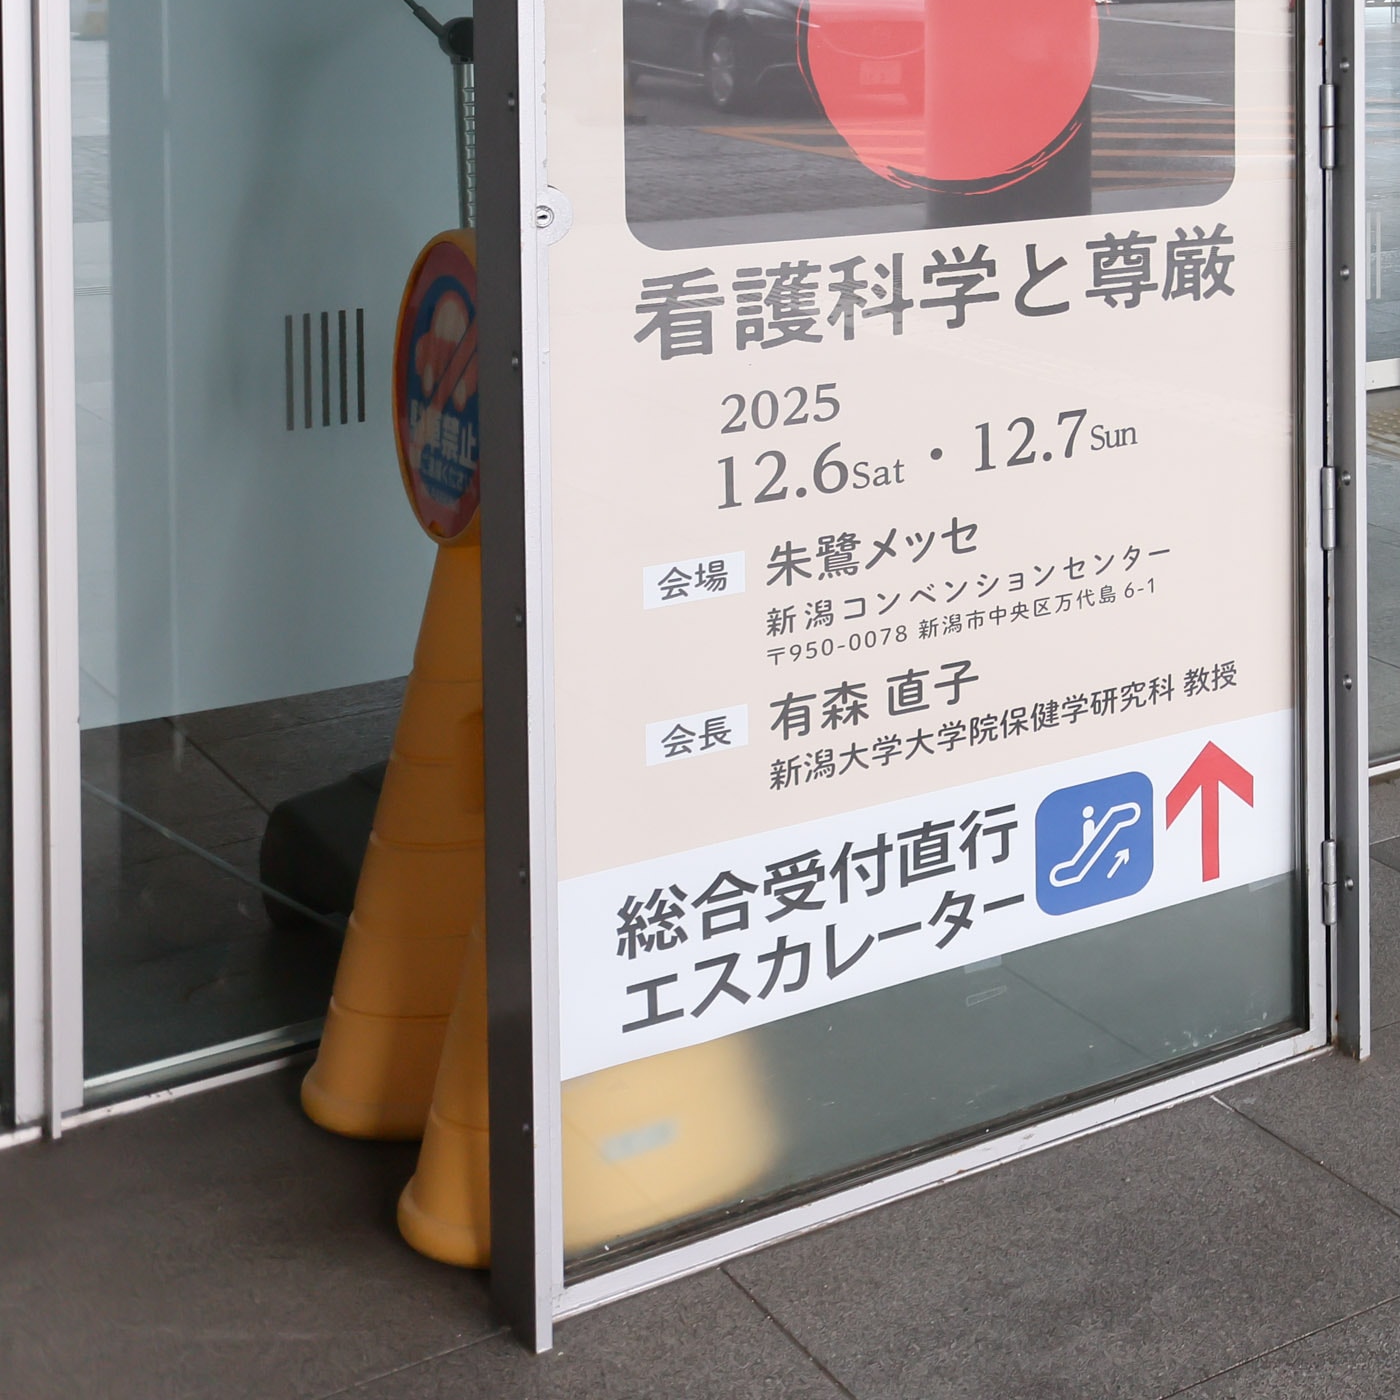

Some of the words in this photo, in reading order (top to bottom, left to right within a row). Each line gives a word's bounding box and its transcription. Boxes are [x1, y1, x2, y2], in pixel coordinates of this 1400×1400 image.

[633, 222, 1236, 361] 看護科学と尊厳
[719, 382, 841, 435] 2025
[657, 559, 729, 601] 会場
[765, 516, 978, 587] 朱鷺メッセ
[765, 544, 1171, 637] 新潟コンベンションセンター
[766, 624, 908, 666] 〒950-0078
[917, 584, 1117, 641] 新潟市中央区万代島
[1123, 577, 1156, 600] 6-1
[660, 715, 733, 758] 会長
[768, 672, 1175, 791] 新潟大学大学院保健学研究科
[1182, 659, 1238, 698] 教授
[769, 680, 870, 741] 有森
[885, 658, 980, 717] 直子
[615, 802, 1019, 961] 総合受付直行
[621, 889, 1026, 1034] エスカレーター
